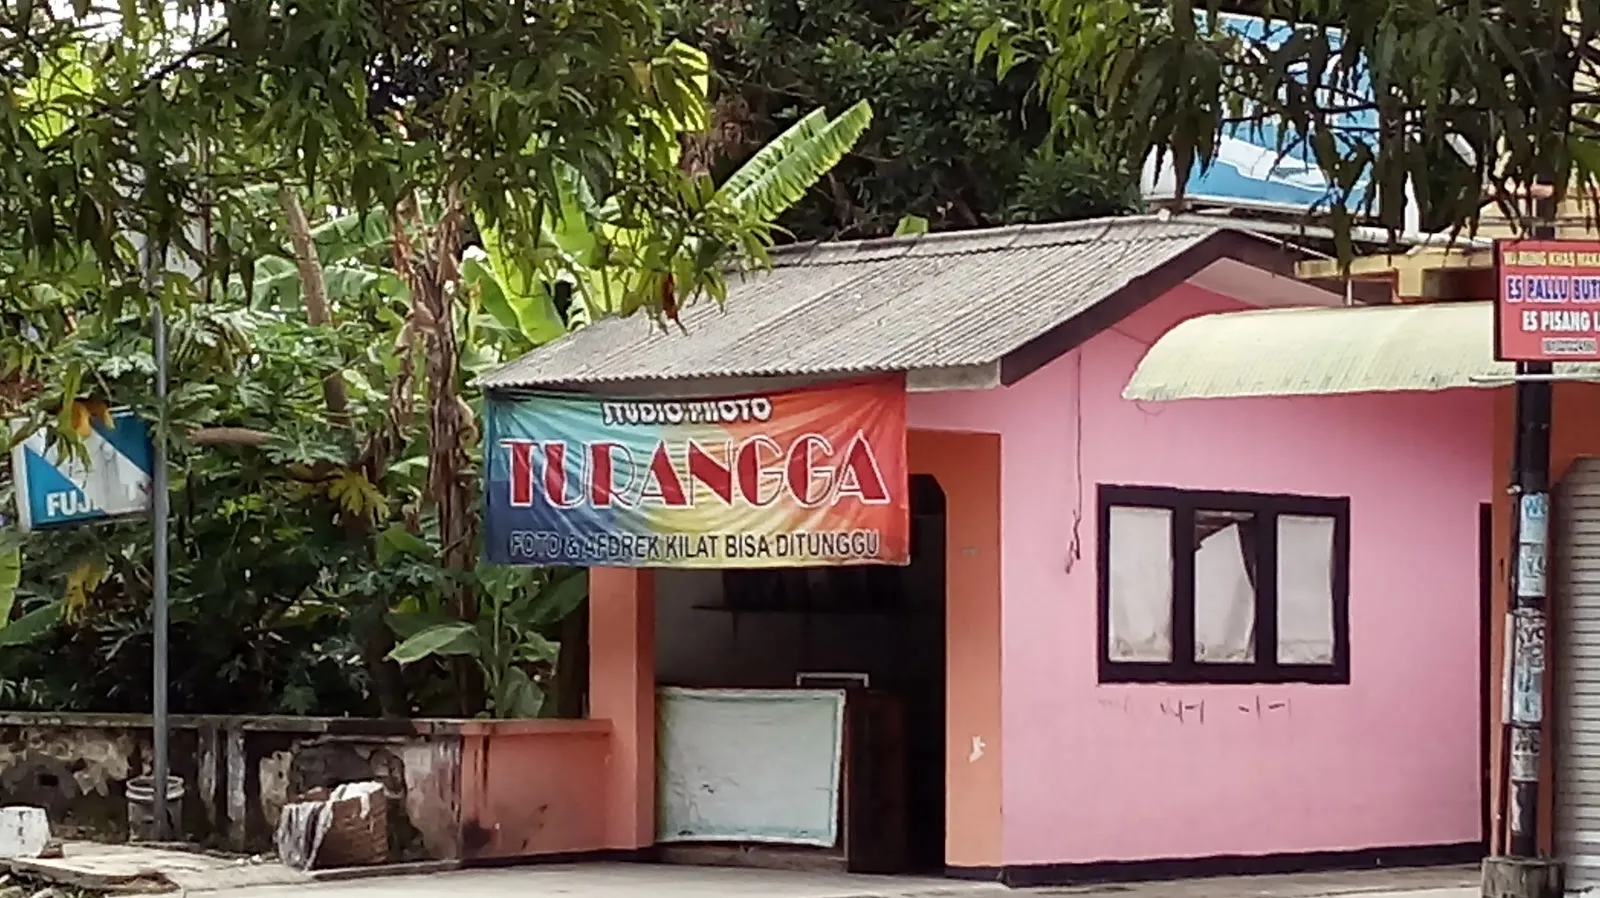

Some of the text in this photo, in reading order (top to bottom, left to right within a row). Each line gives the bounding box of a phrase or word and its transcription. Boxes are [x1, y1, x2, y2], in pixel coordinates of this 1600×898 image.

[1506, 275, 1523, 302] ES
[1525, 275, 1568, 302] PALLU
[1522, 310, 1539, 331] ES
[1541, 310, 1591, 332] PISANG
[602, 397, 773, 426] STUDIO PHOTO
[500, 428, 891, 510] TURANGGA
[509, 531, 562, 559] FOTO
[664, 532, 718, 559] KILAT
[724, 532, 770, 558] BISA
[775, 529, 881, 558] DITUNGGU
